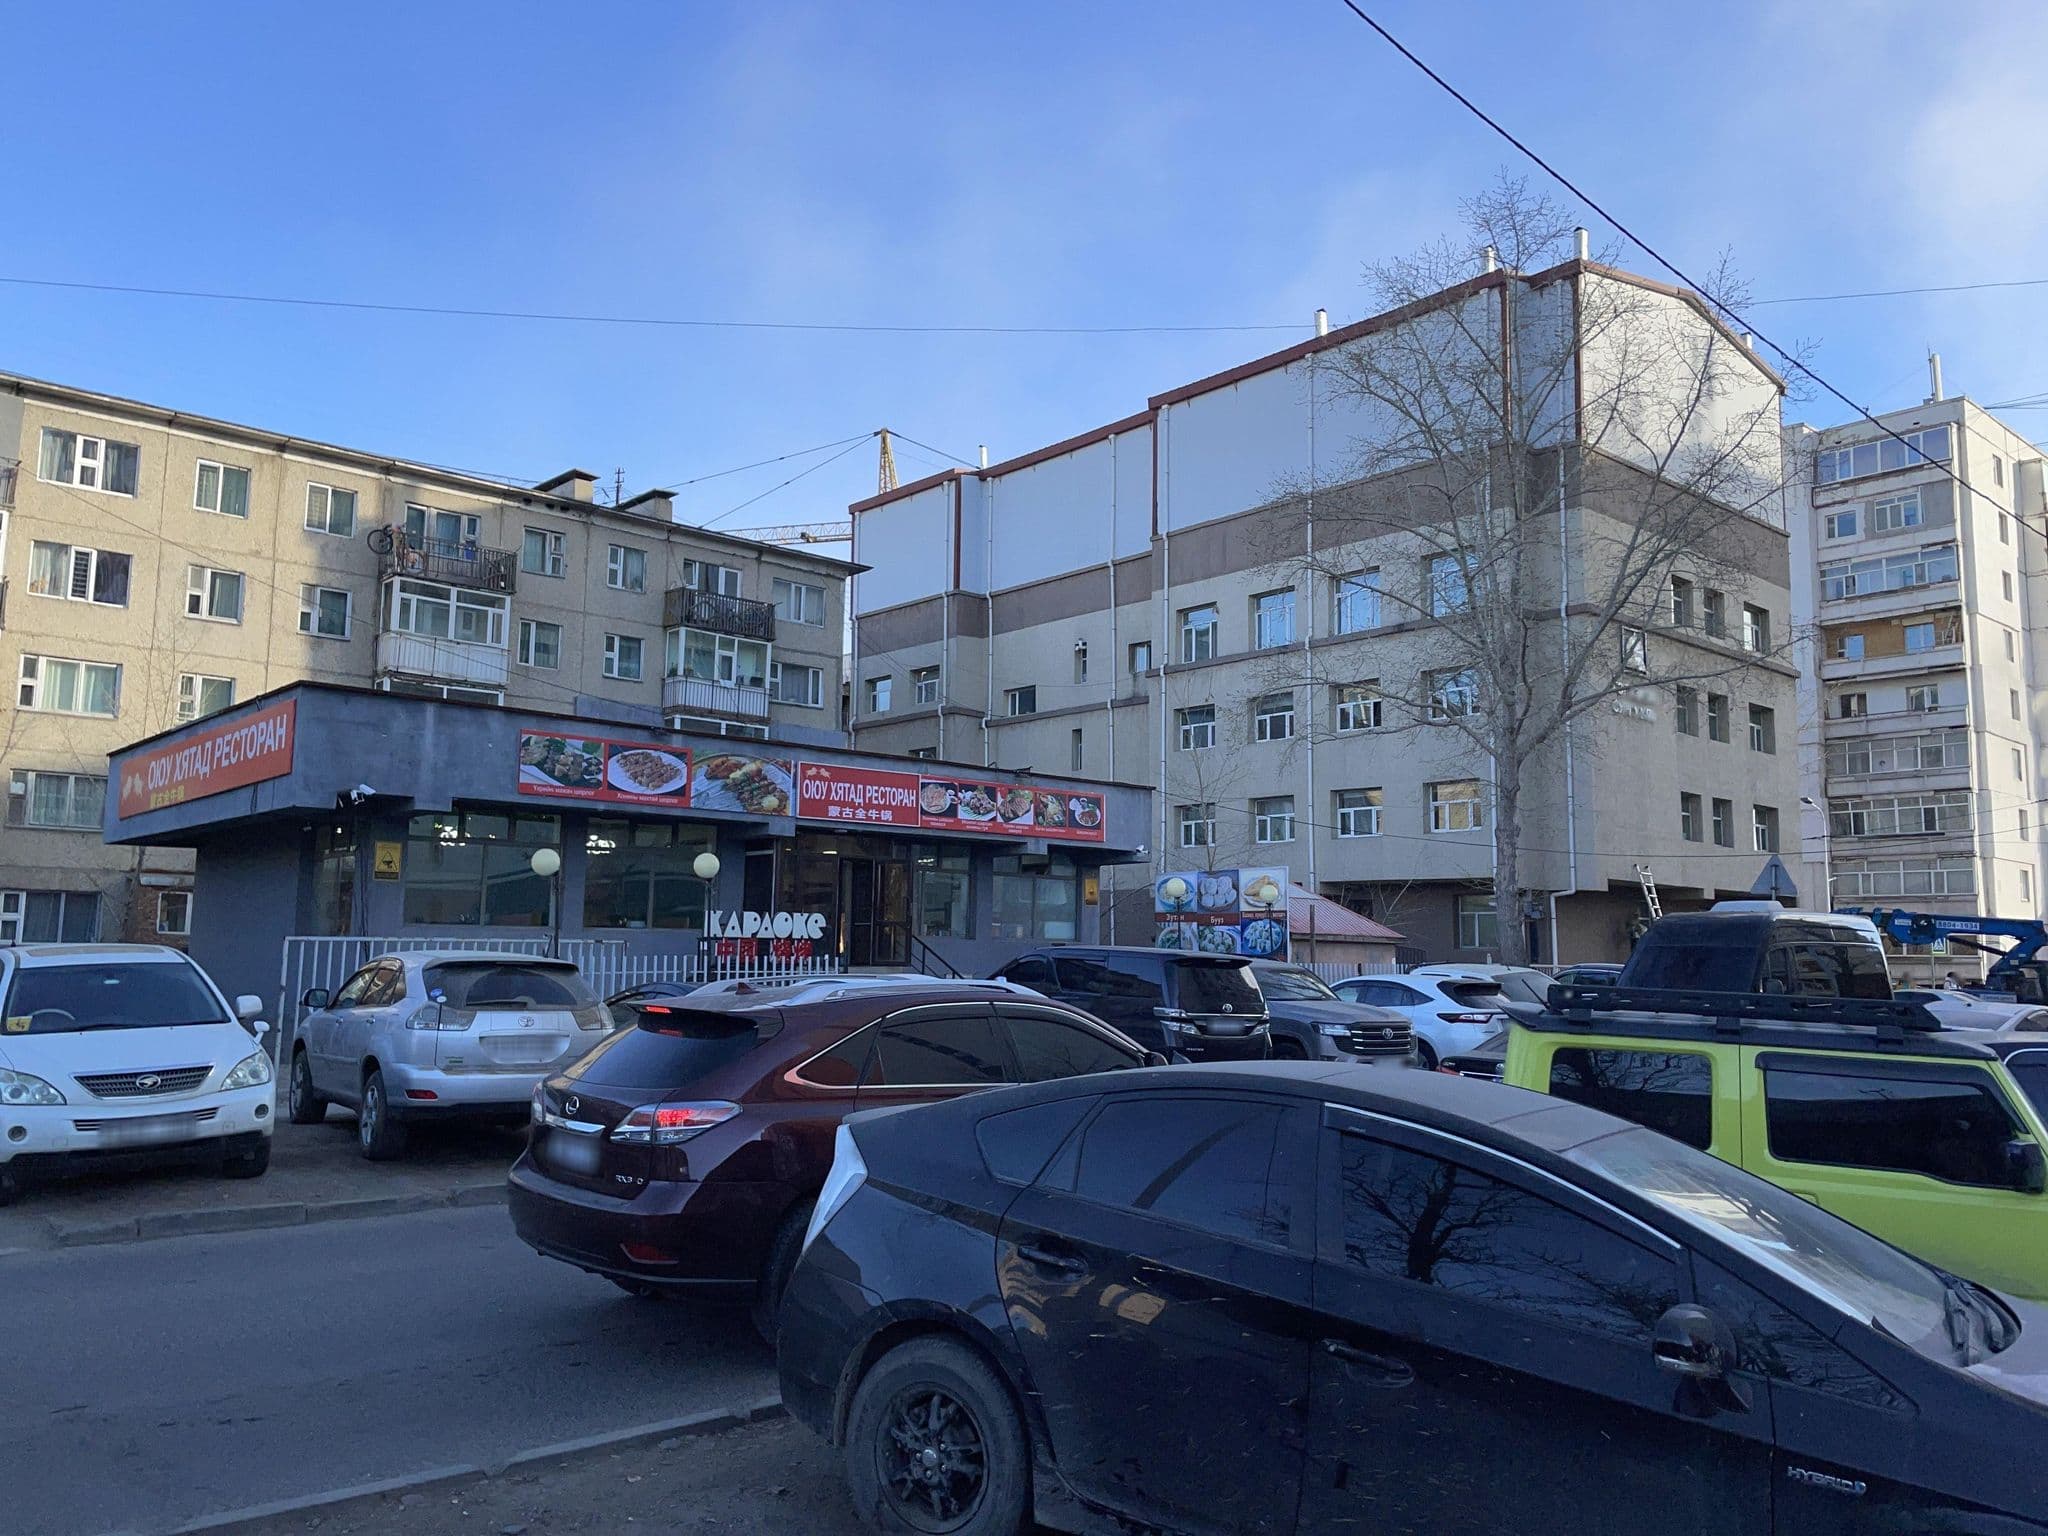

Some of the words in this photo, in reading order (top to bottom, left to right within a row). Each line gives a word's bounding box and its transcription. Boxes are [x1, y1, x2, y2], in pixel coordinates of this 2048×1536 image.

[147, 754, 173, 790] ОЮУ
[173, 740, 211, 782] ХЯТАД
[213, 714, 287, 769] РЕСТОРАН
[803, 779, 828, 800] ОЮУ
[830, 782, 863, 806] ХЯТАД
[866, 785, 916, 807] РЕСТОРАН
[615, 1174, 644, 1185] RX30
[1786, 1466, 1855, 1494] HYBRID
